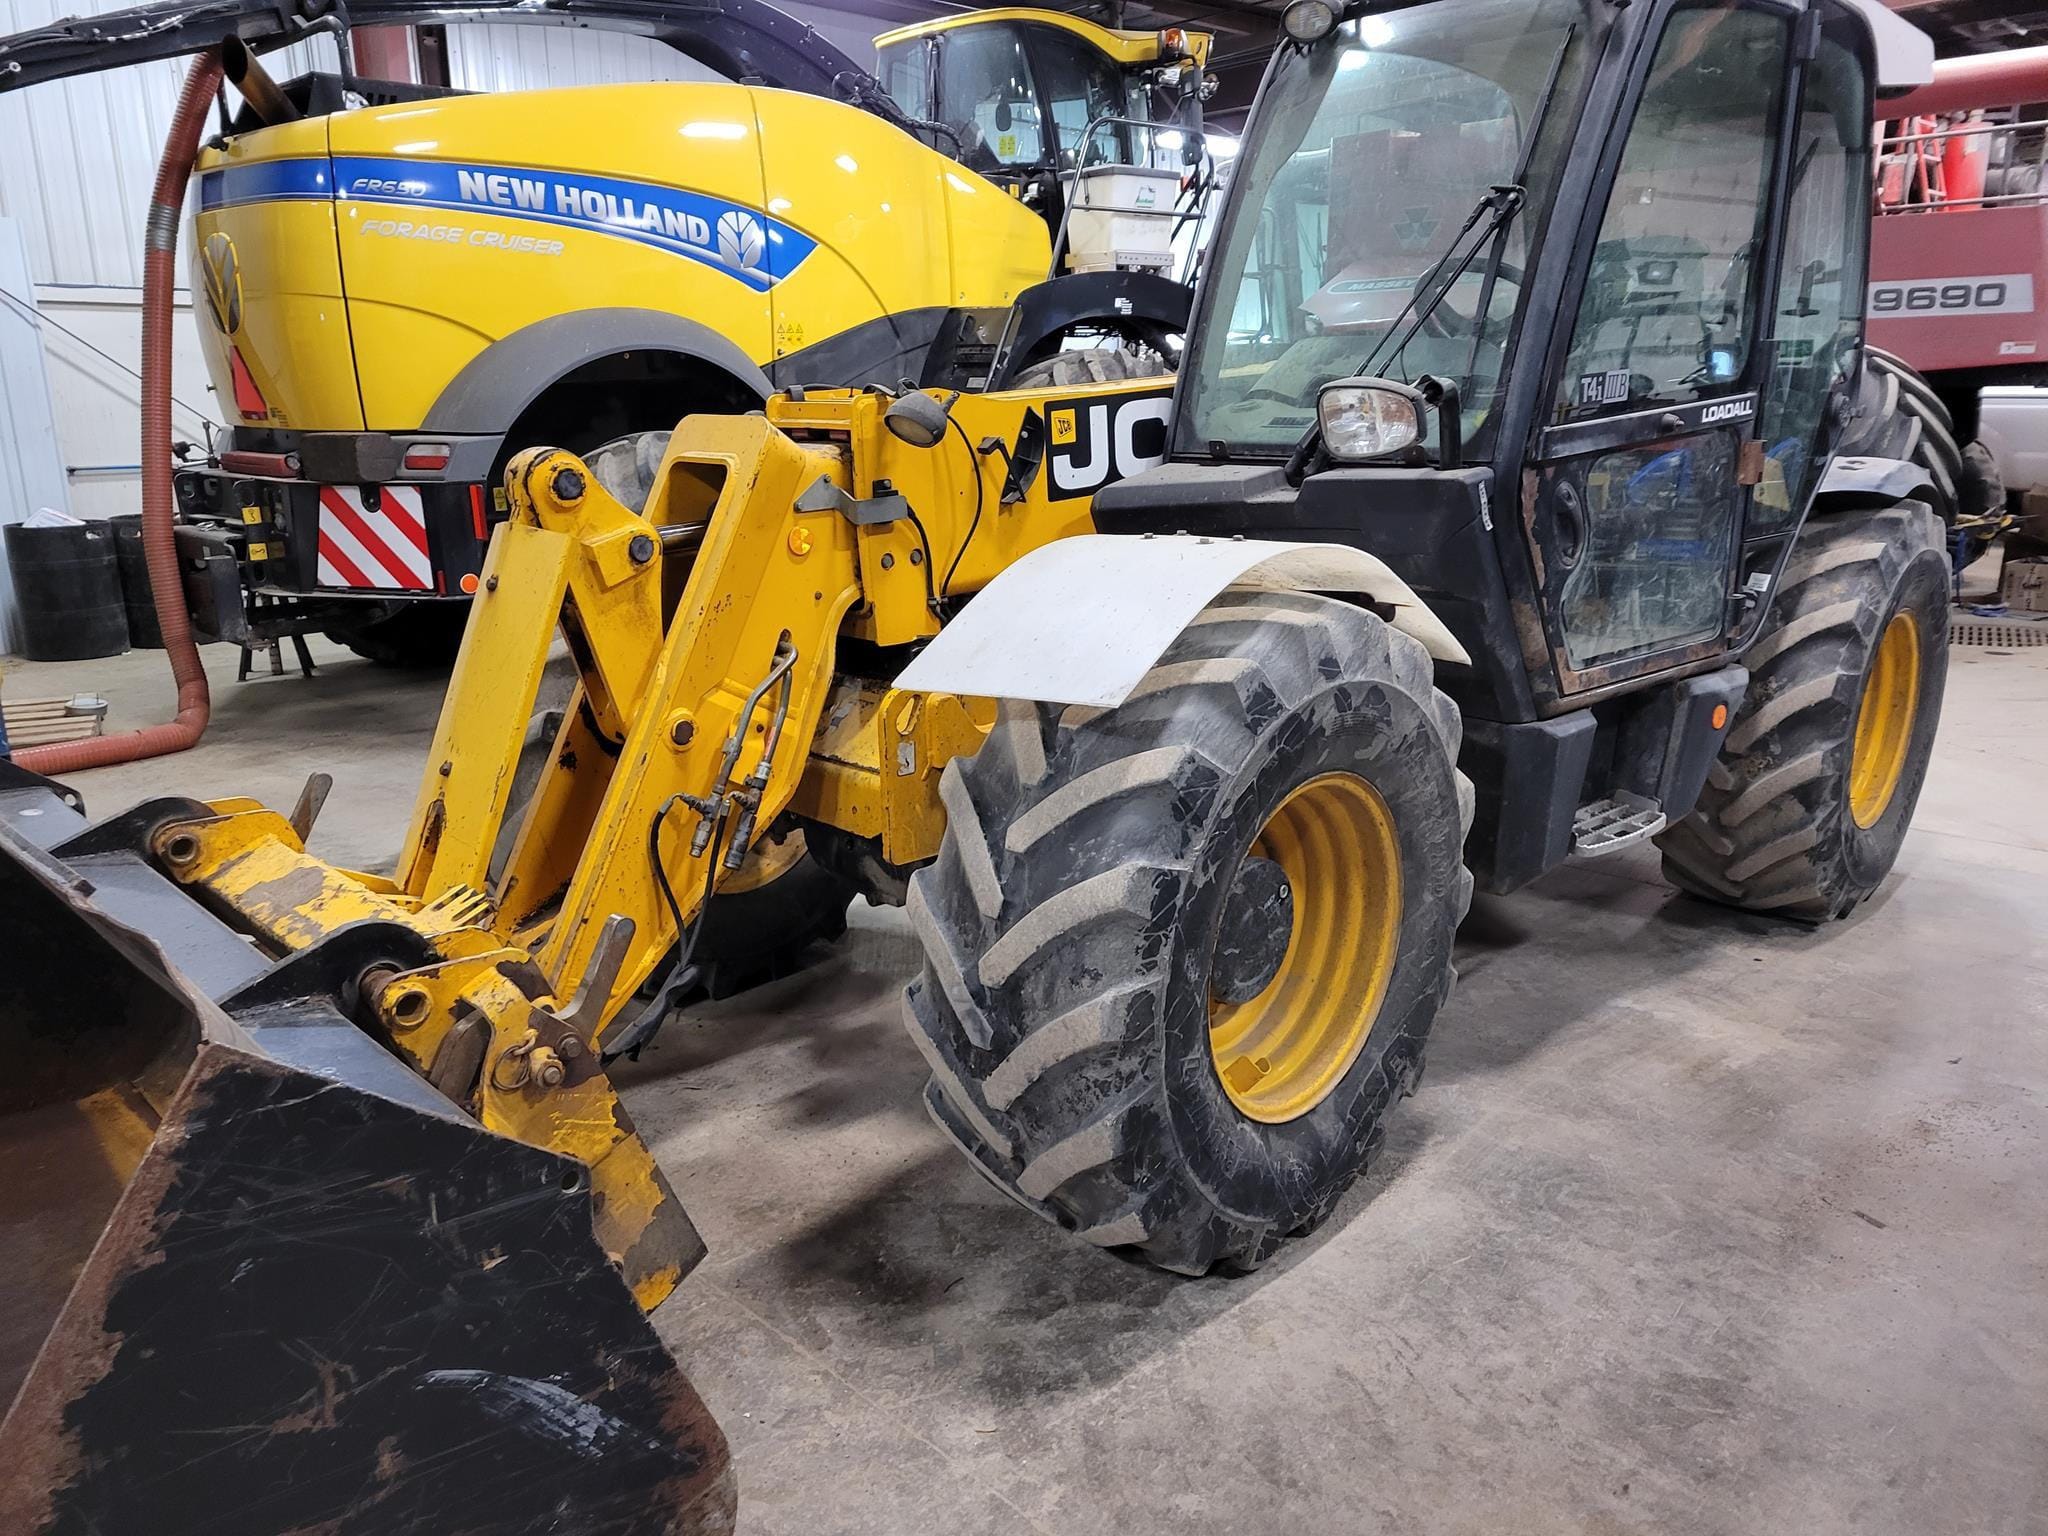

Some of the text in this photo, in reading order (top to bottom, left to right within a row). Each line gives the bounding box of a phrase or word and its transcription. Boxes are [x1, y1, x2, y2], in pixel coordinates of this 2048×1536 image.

[352, 178, 428, 198] FR650
[457, 170, 710, 245] NEW HOLLAND
[360, 219, 565, 256] FORAGE CRUISER
[1873, 282, 2007, 311] 9690
[1701, 400, 1753, 424] LOADALL
